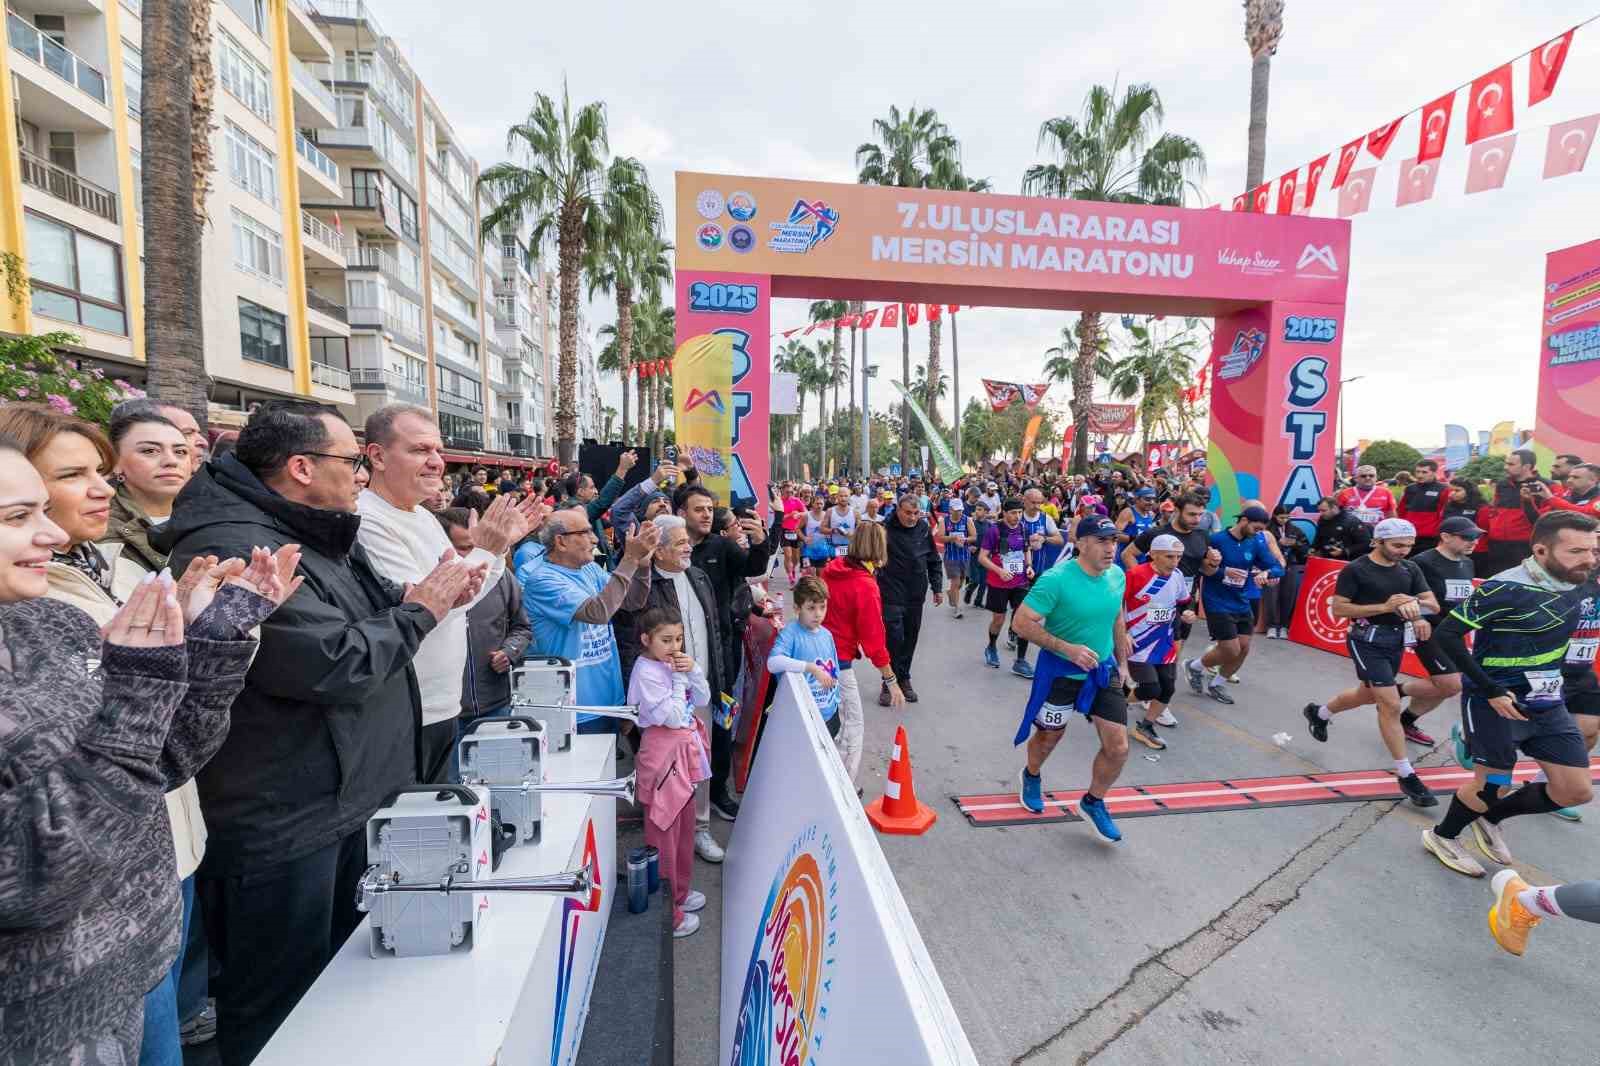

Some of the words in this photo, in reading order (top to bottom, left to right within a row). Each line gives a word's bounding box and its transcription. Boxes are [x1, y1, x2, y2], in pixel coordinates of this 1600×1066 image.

[897, 202, 1180, 247] 7.ULUSLARARASI
[873, 233, 1003, 268] MERSİN
[1011, 243, 1195, 279] MARATONU
[689, 281, 758, 312] 2025
[1284, 315, 1337, 343] 2025
[1044, 711, 1062, 725] 58
